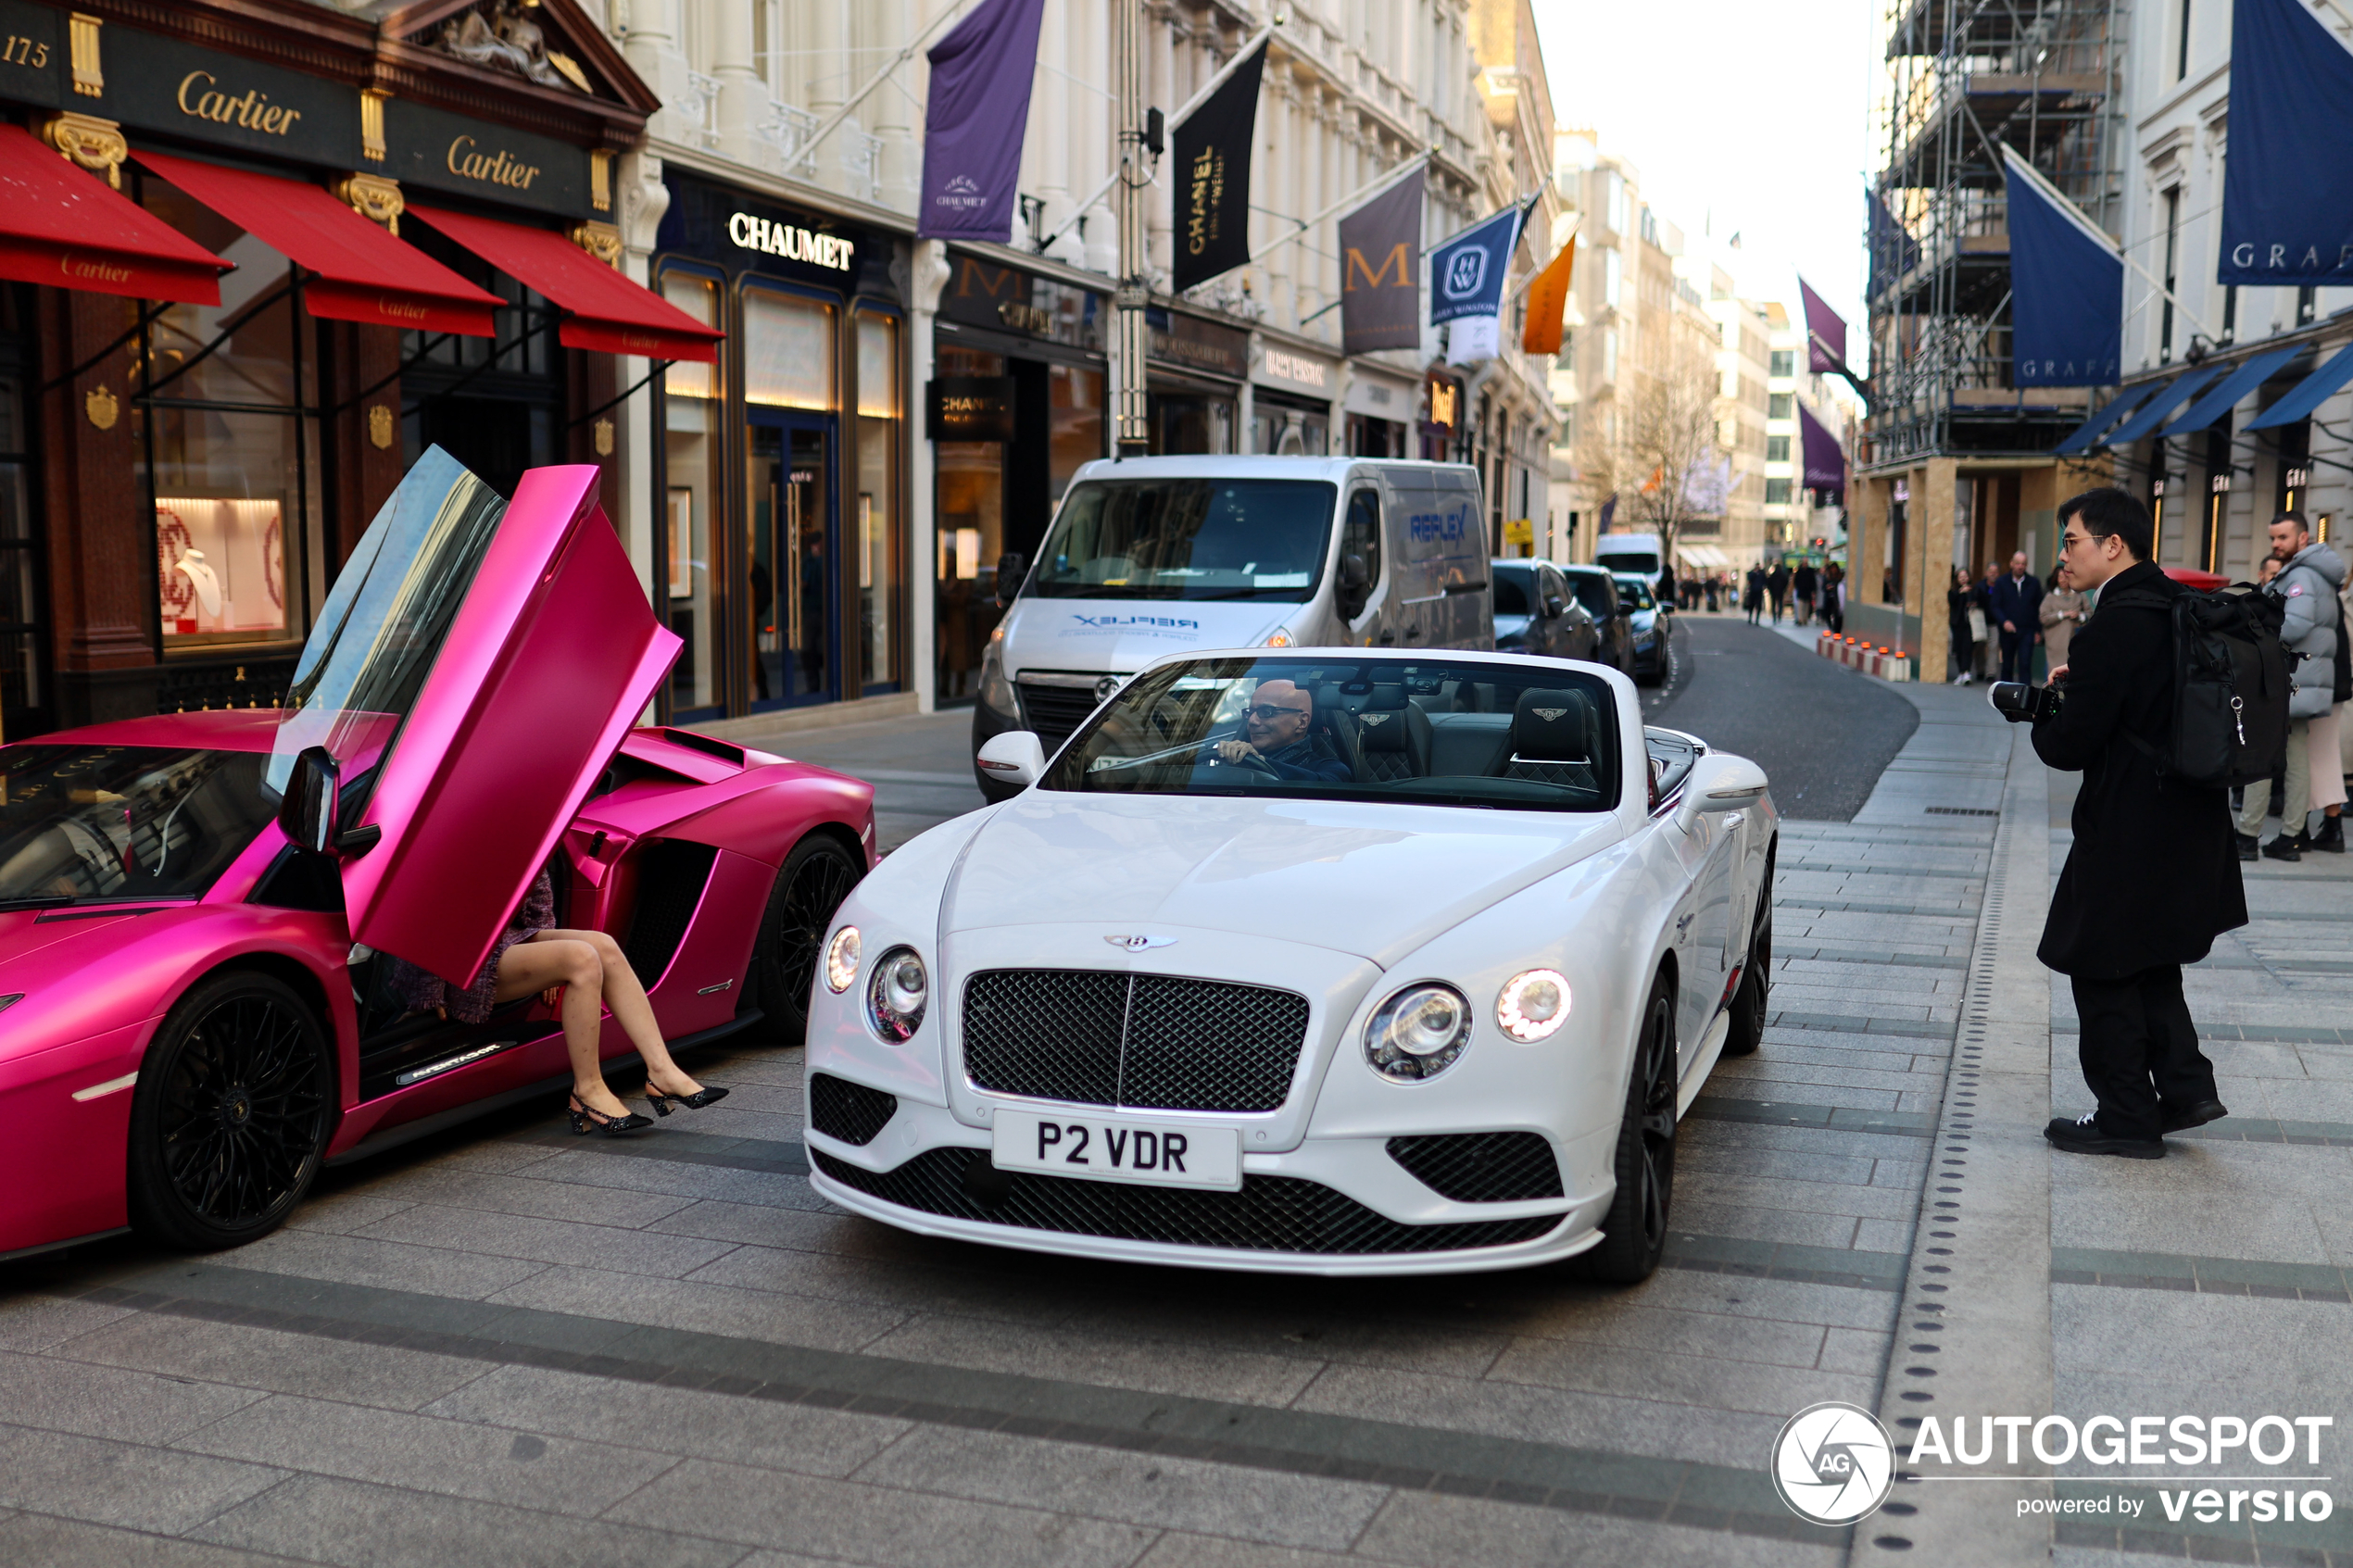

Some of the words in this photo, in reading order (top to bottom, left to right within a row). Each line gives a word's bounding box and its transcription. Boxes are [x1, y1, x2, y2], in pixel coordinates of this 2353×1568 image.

[2, 35, 50, 69] 175
[178, 70, 301, 136] Cartier
[447, 134, 541, 190] Cartier
[936, 195, 988, 207] CHAUMET
[1189, 145, 1213, 255] CHANEL
[729, 212, 854, 271] CHAUMET
[61, 253, 133, 283] Cartier
[1343, 243, 1416, 293] M
[379, 294, 430, 320] Cartier
[1454, 302, 1497, 315] WINSTON
[2022, 359, 2115, 378] GRAFF
[942, 396, 1005, 411] CHAN
[1411, 503, 1467, 550] REFLEX
[413, 1044, 500, 1077] AVENTADOR
[1038, 1122, 1089, 1165] P2
[1104, 1128, 1188, 1173] VDR
